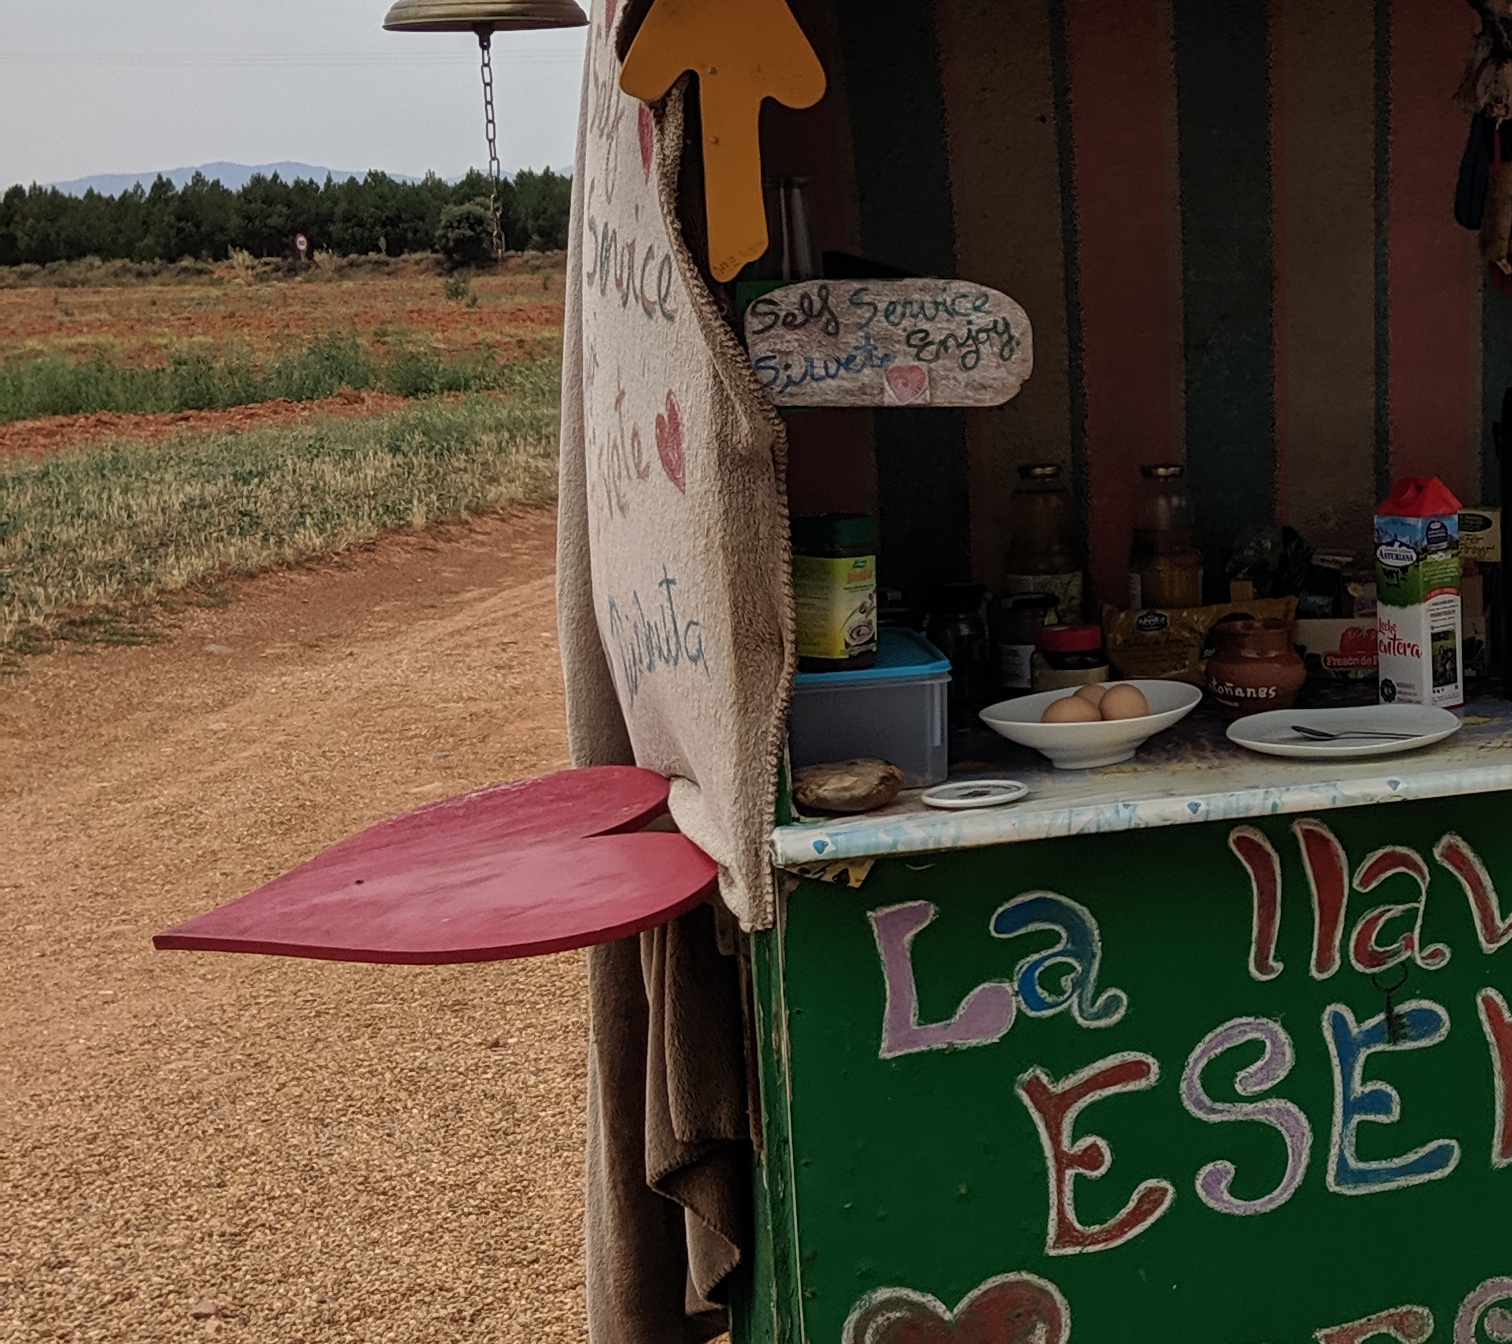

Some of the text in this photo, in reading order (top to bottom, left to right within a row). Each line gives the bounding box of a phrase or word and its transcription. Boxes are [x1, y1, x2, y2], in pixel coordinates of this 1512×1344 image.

[752, 284, 993, 337] Self Service
[1379, 633, 1423, 659] entera
[866, 890, 1128, 1059] La
